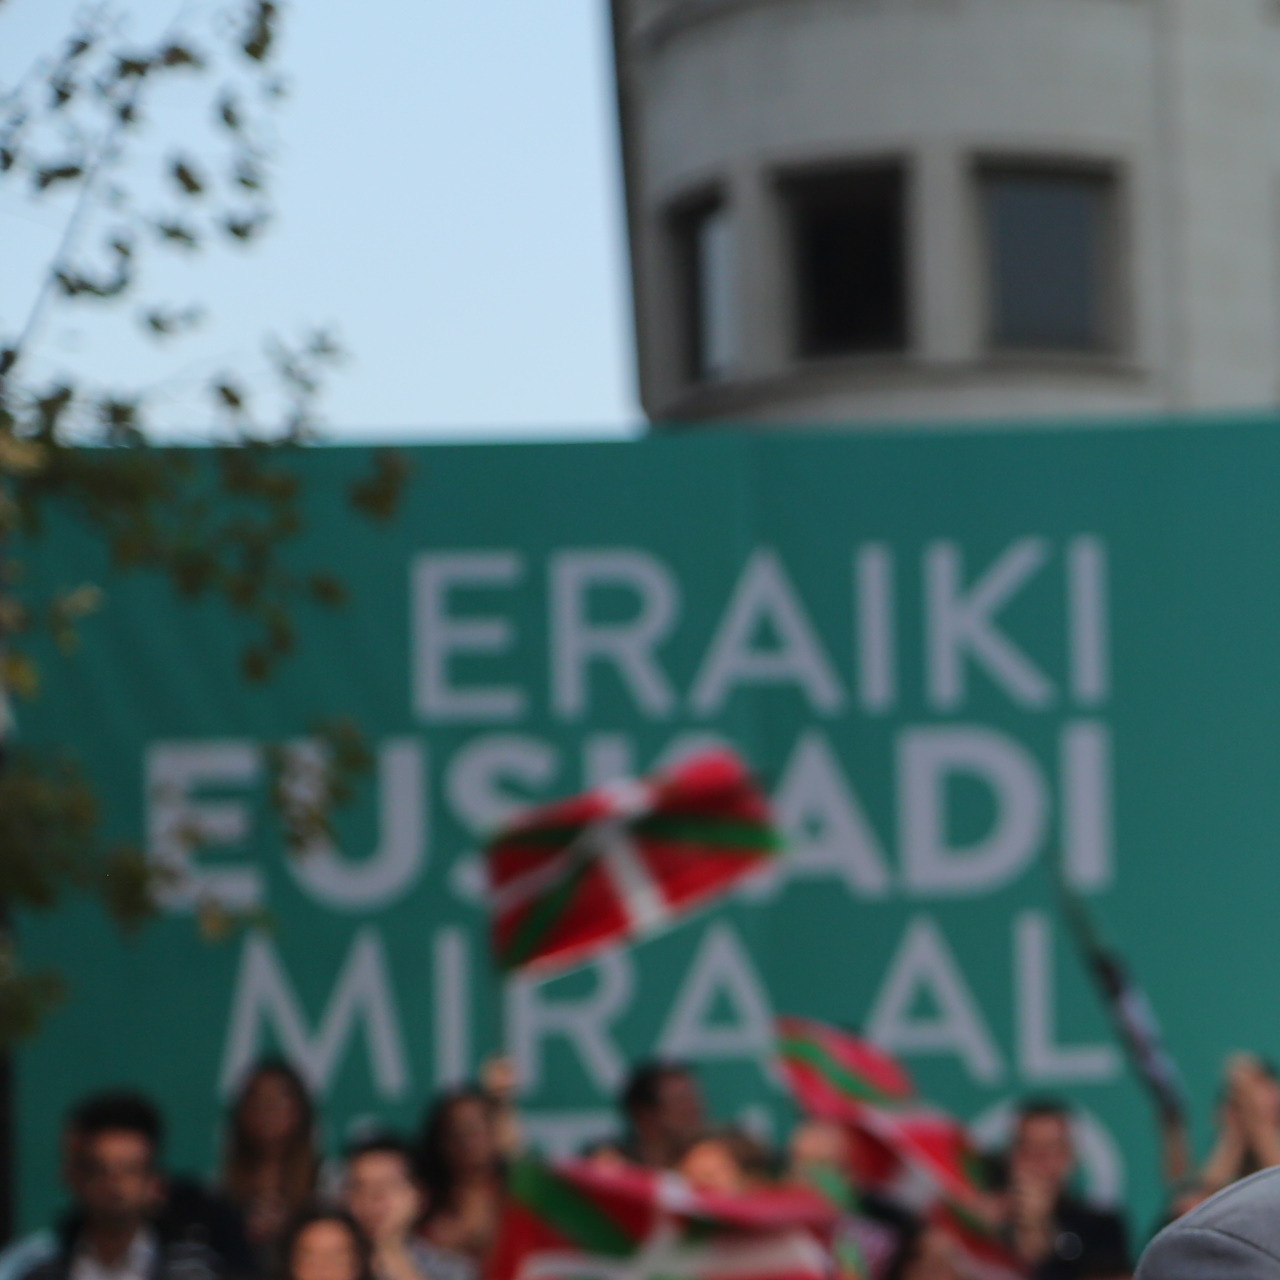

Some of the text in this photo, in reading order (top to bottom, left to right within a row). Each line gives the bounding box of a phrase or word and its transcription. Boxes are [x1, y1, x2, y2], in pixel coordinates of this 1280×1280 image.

[412, 538, 1108, 718] ERAIKI
[146, 724, 1110, 908] EUSADI
[222, 912, 1122, 1098] MIRA AL
